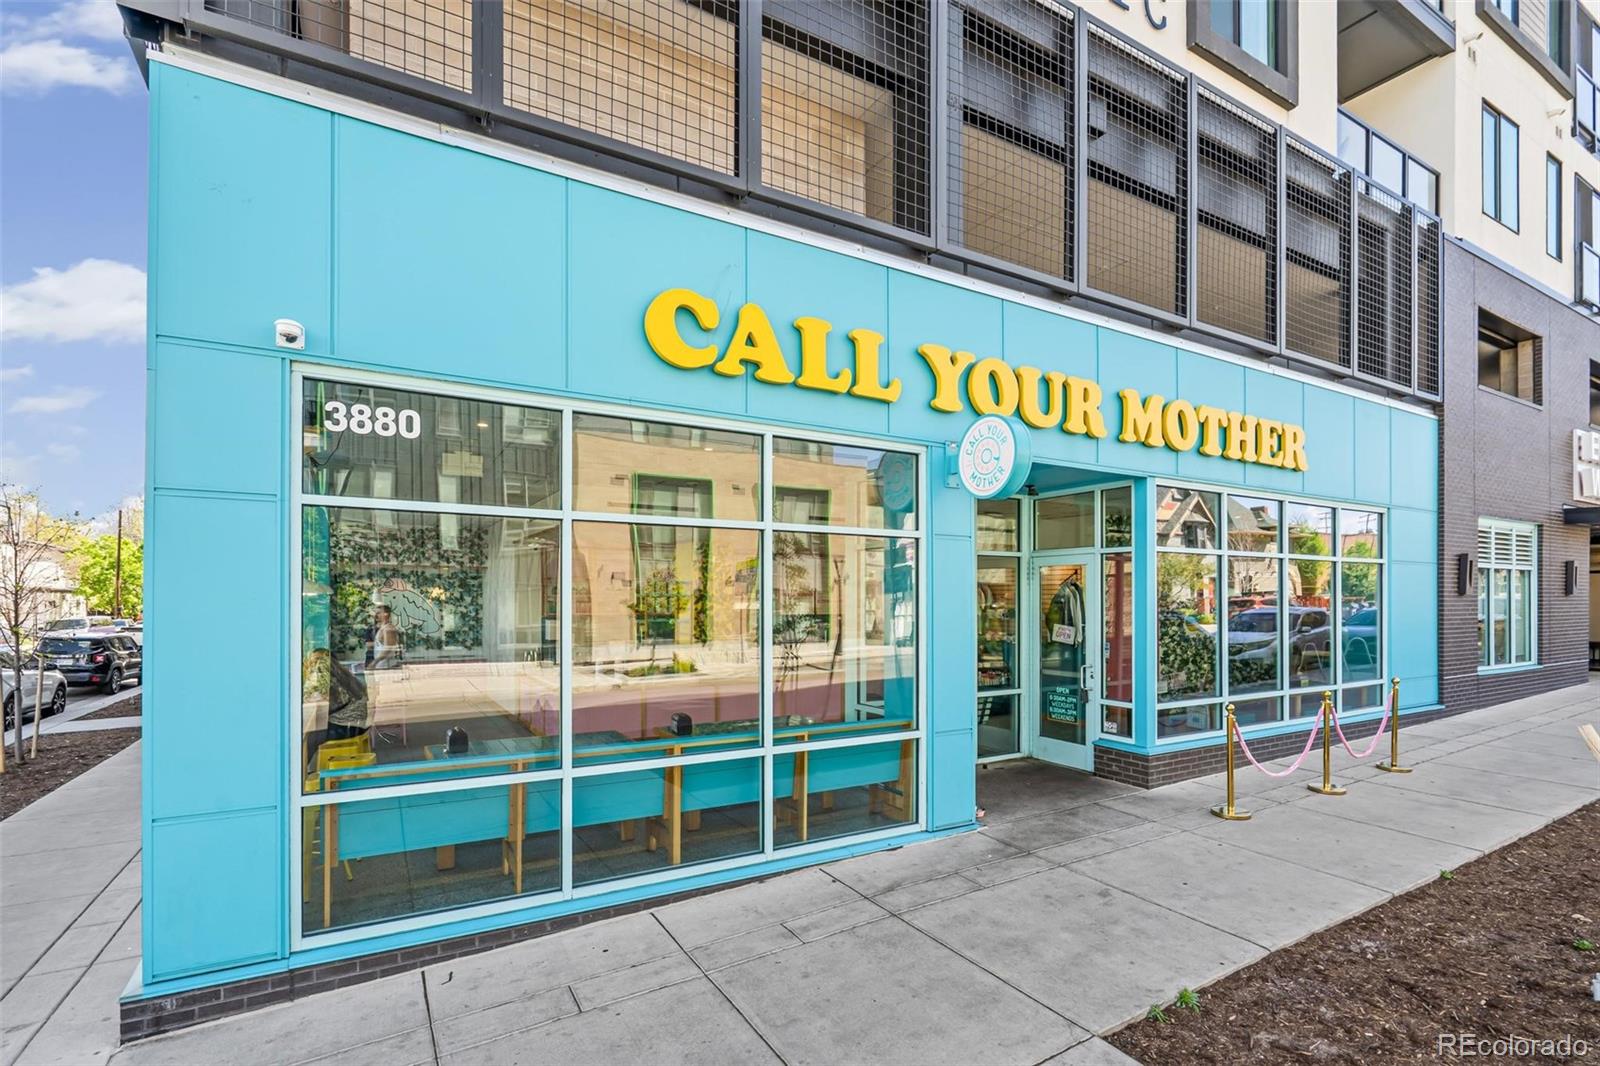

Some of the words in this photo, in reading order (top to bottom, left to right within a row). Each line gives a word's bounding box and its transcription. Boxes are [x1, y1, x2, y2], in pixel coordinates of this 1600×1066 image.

[644, 287, 902, 404] CALL
[917, 343, 1108, 439] YOUR
[1118, 388, 1309, 473] MOTHER
[324, 401, 421, 439] 3880
[966, 430, 984, 456] CALL
[987, 424, 1008, 445] YOUR
[970, 466, 1005, 487] MOTHER
[1051, 701, 1075, 710] WEEKDAYS
[1051, 713, 1075, 721] WEEKENDS
